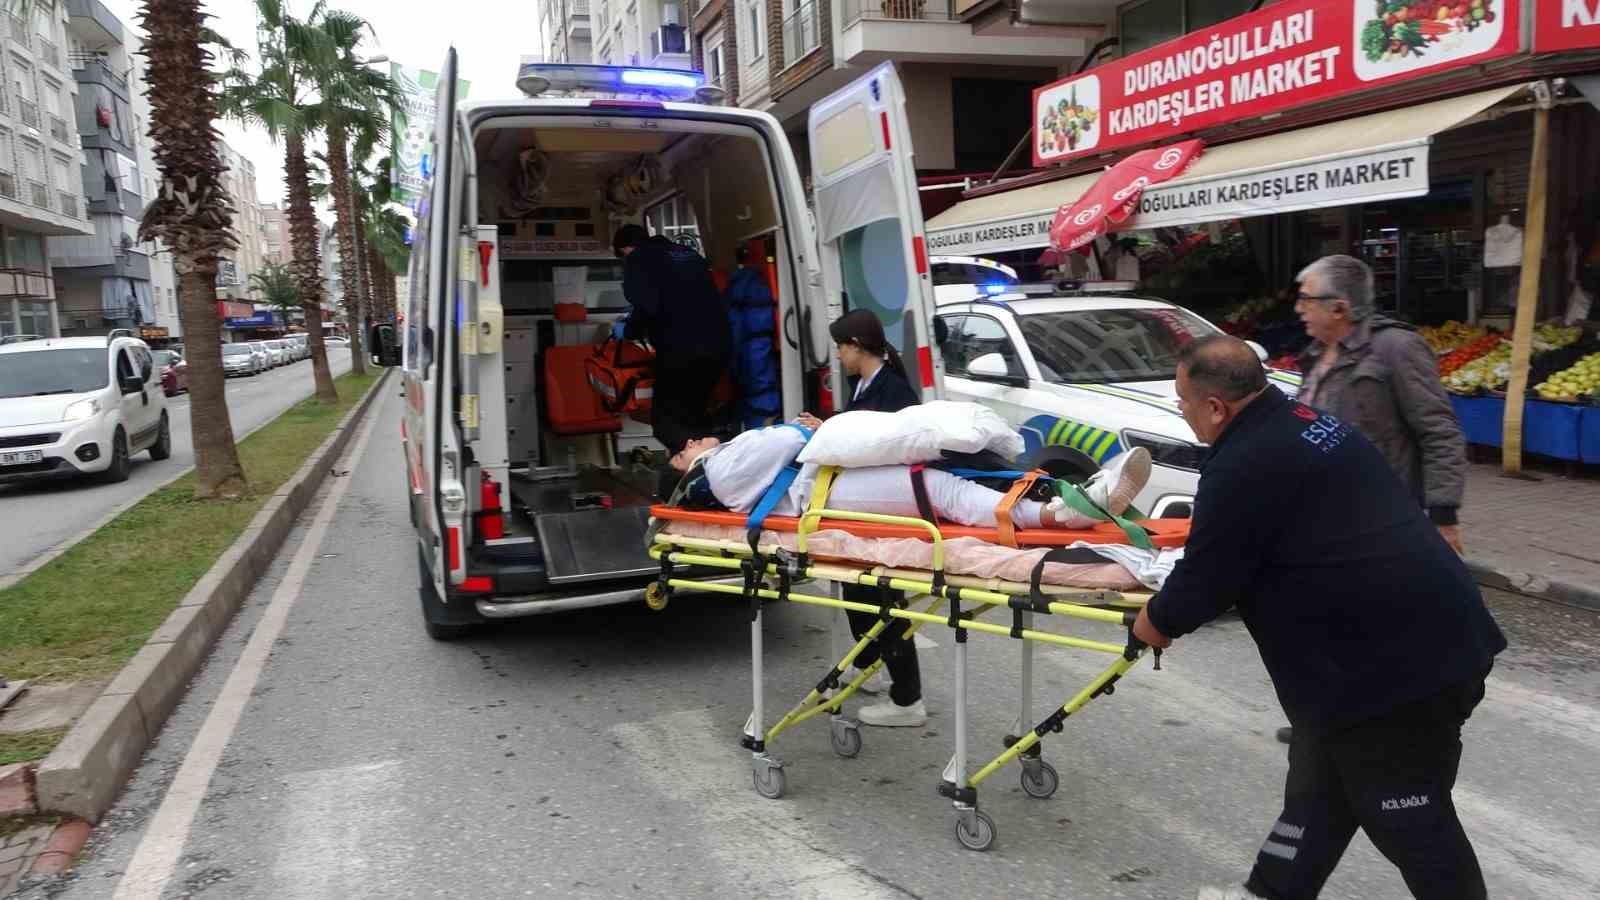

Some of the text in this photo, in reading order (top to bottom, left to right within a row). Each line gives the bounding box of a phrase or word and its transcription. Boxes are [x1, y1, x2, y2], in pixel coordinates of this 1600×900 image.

[1124, 8, 1314, 96] DURANOĞULLARI
[1108, 46, 1341, 127] KARDEŞLER MARKET
[1216, 171, 1319, 201] KARDEŞLER
[1325, 156, 1416, 189] MARKET
[975, 222, 1036, 243] KARDEŞLER
